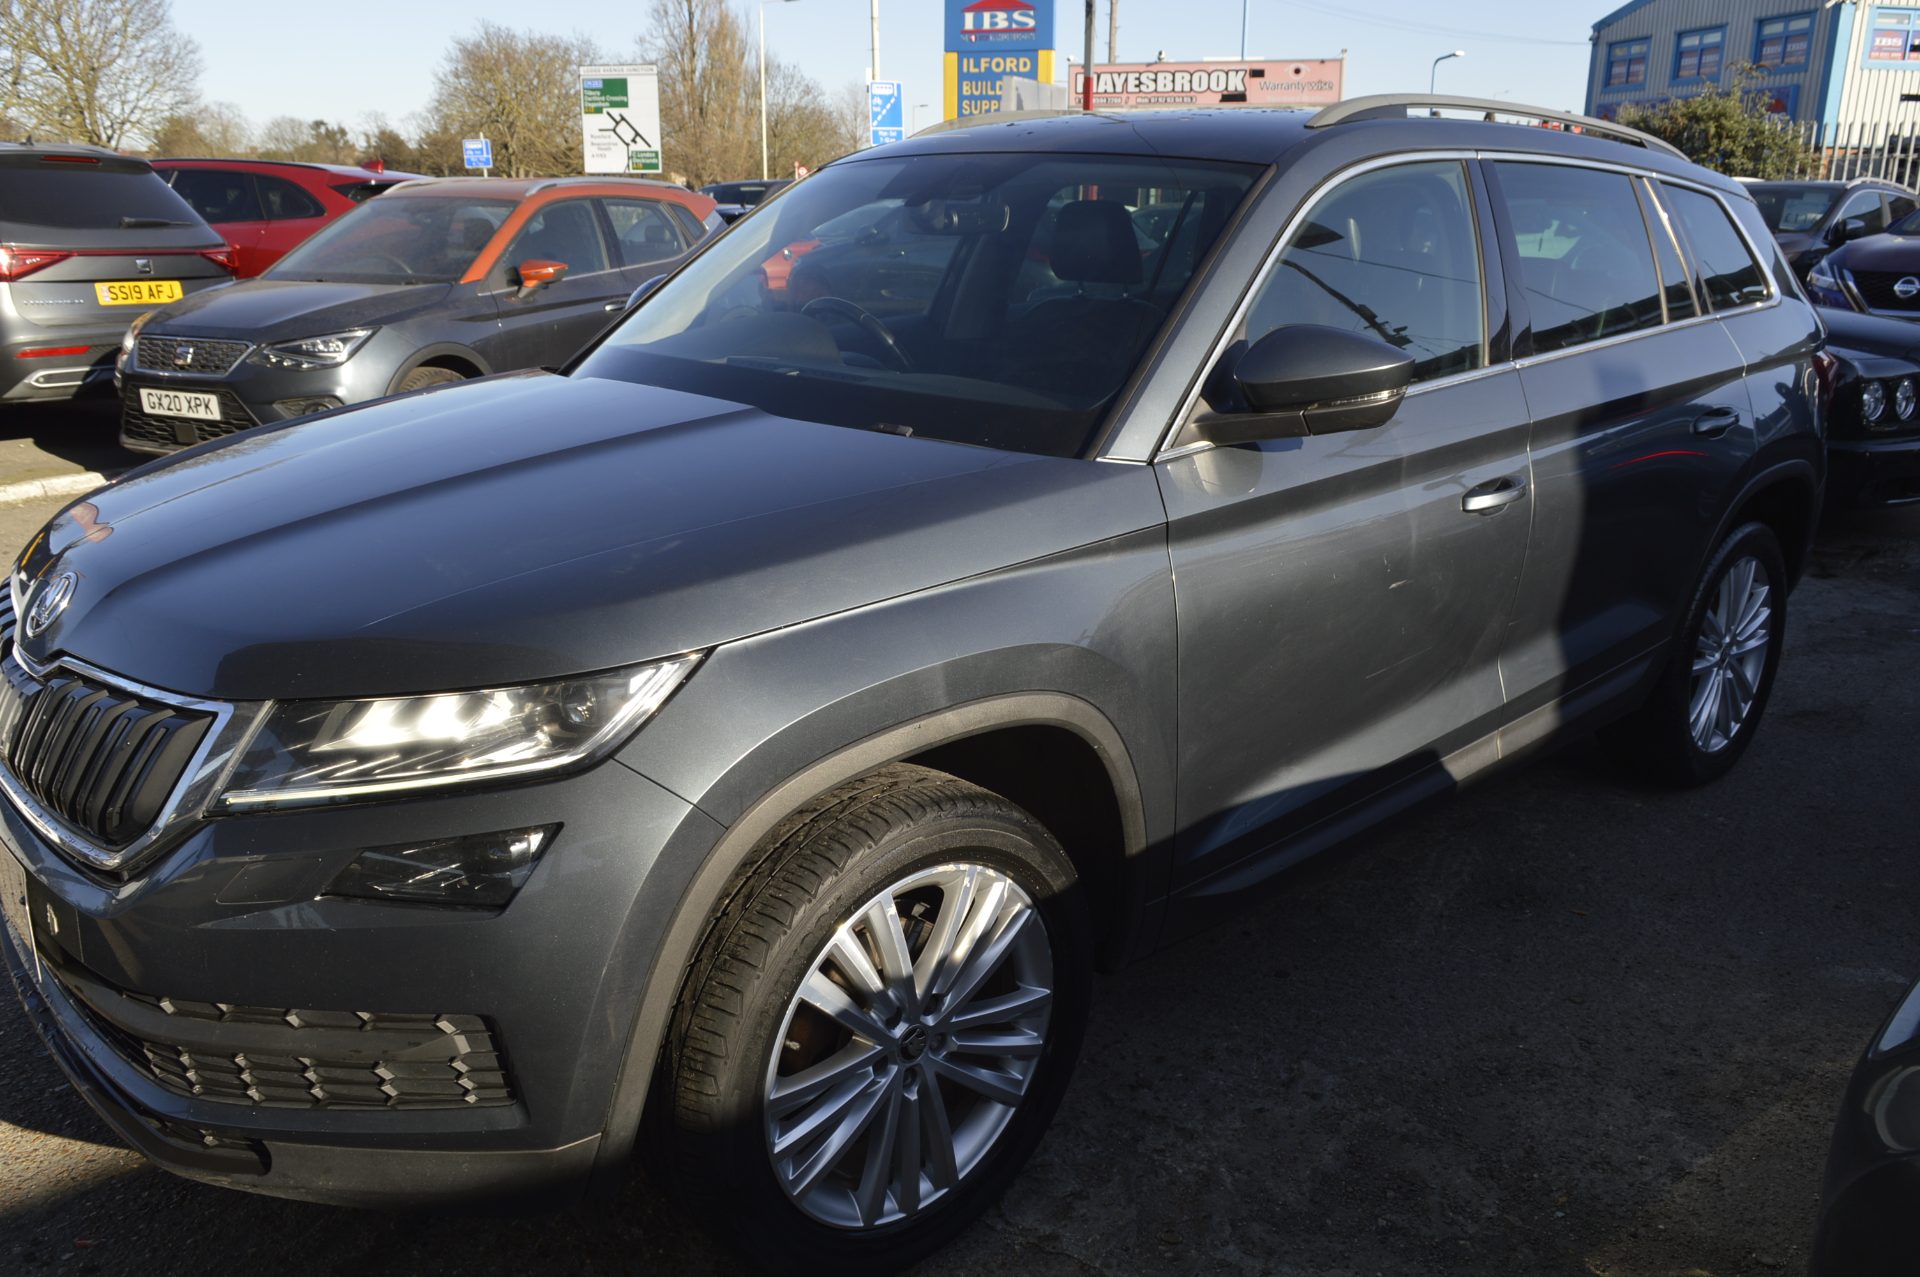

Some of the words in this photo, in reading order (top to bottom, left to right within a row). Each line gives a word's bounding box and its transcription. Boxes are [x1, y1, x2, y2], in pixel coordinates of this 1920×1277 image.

[963, 9, 1036, 30] IBS
[962, 57, 1032, 73] ILFORD
[108, 284, 143, 300] SS19
[148, 284, 175, 299] AFJ
[146, 392, 182, 412] GX20
[184, 395, 214, 416] XPK
